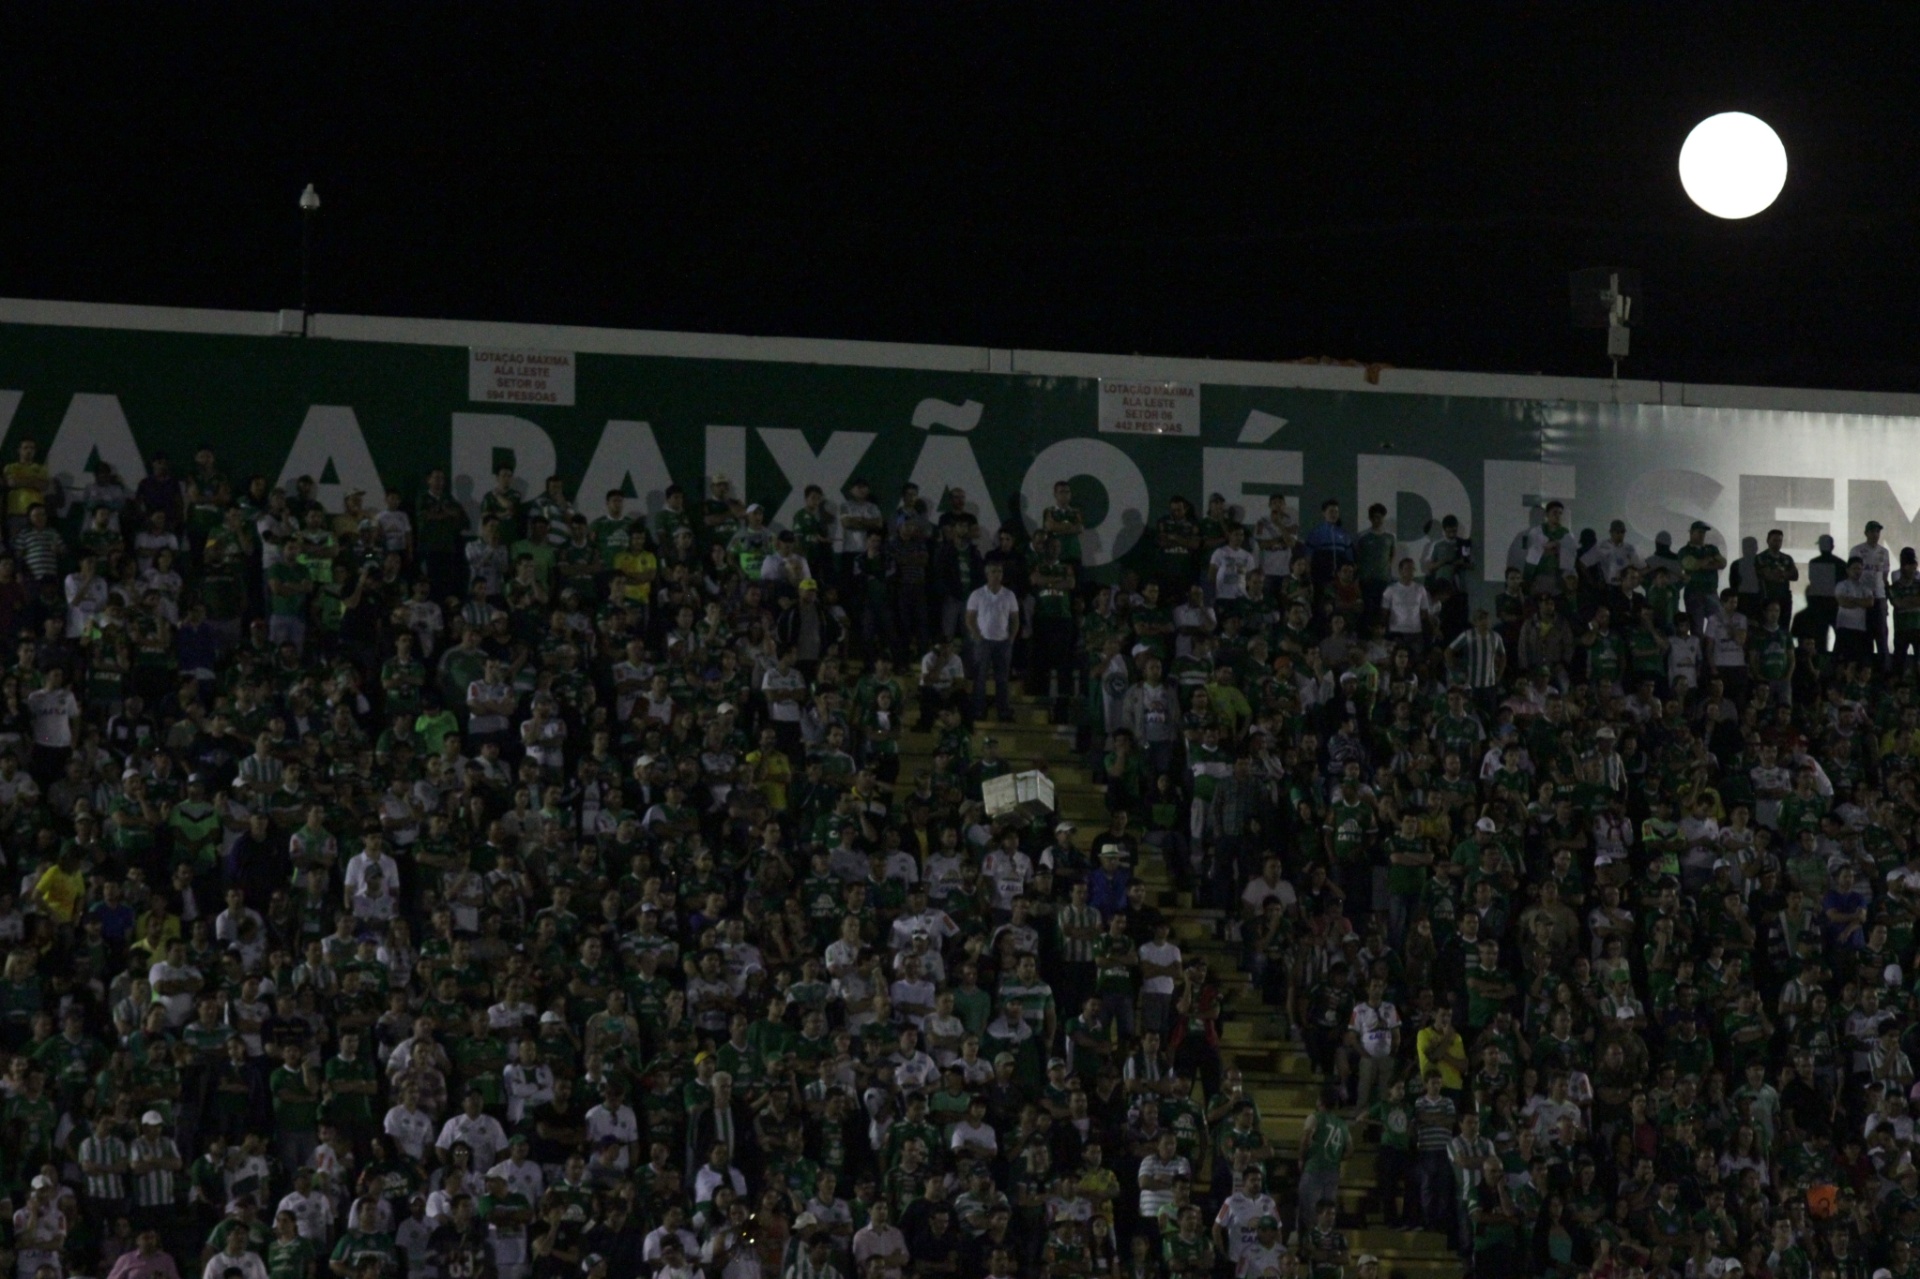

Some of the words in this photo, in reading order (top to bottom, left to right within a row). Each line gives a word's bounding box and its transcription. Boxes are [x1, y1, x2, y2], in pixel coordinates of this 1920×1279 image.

[494, 365, 514, 376] ALA
[517, 366, 550, 377] LESTE
[497, 377, 532, 388] SETOR
[507, 390, 557, 402] PESSOAS
[1122, 397, 1142, 407] ALA
[1144, 398, 1176, 409] LESTE
[1125, 409, 1159, 420] SETOR
[268, 404, 388, 514] A
[451, 398, 1150, 567] PAIXÃO
[1202, 408, 1304, 540] É
[1356, 453, 1576, 582] DE
[1324, 1123, 1342, 1151] 74
